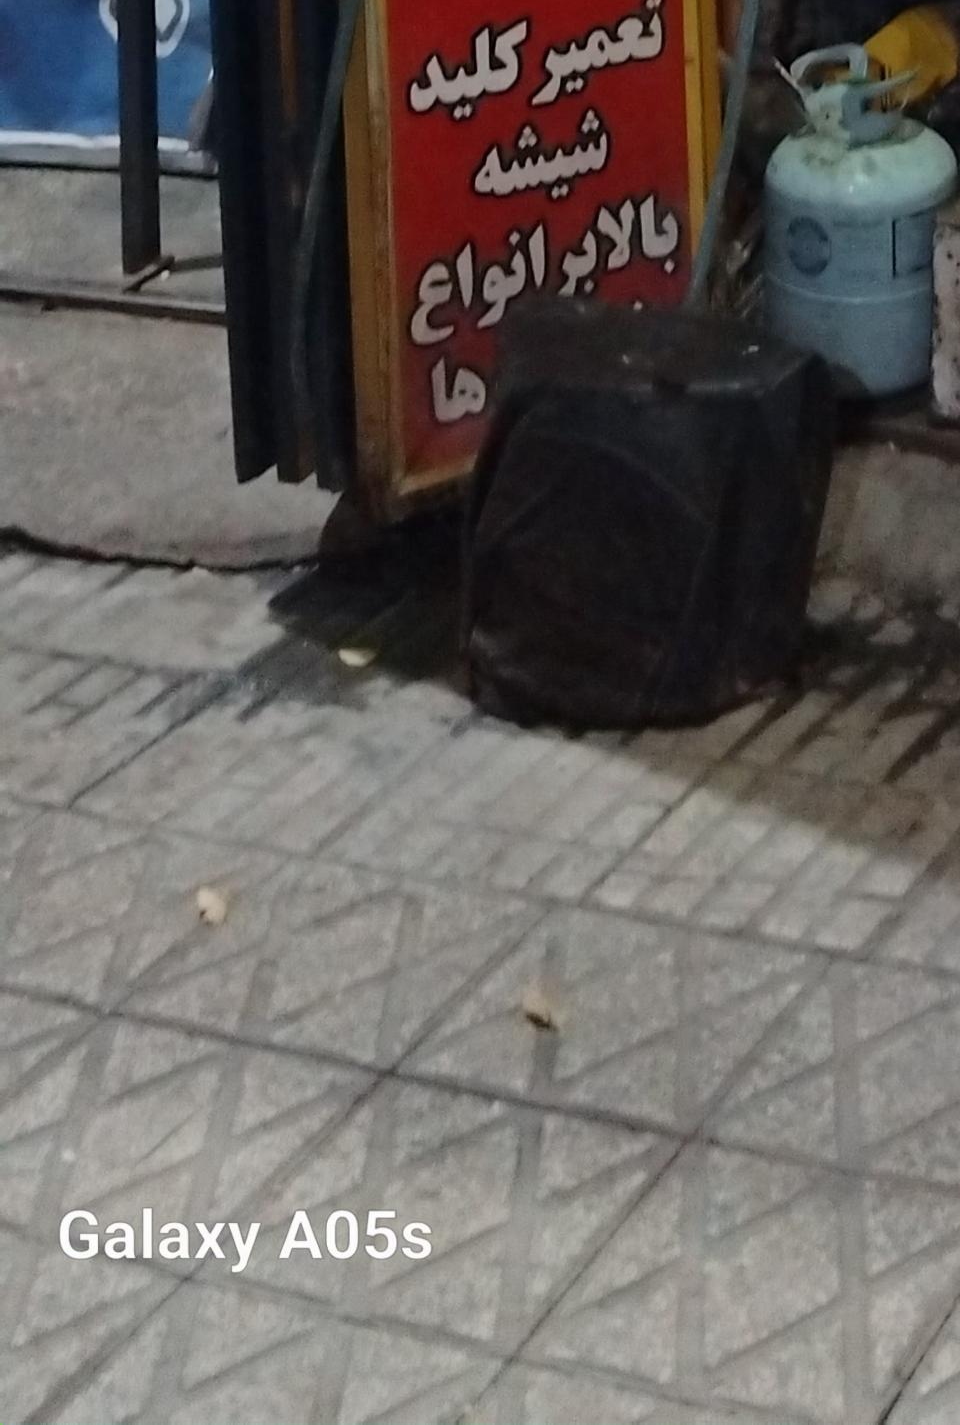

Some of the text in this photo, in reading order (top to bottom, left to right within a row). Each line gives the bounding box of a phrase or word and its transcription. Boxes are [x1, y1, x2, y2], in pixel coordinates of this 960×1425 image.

[409, 21, 530, 120] کلید
[474, 109, 608, 199] شیشه
[411, 195, 679, 345] بالابر انواع
